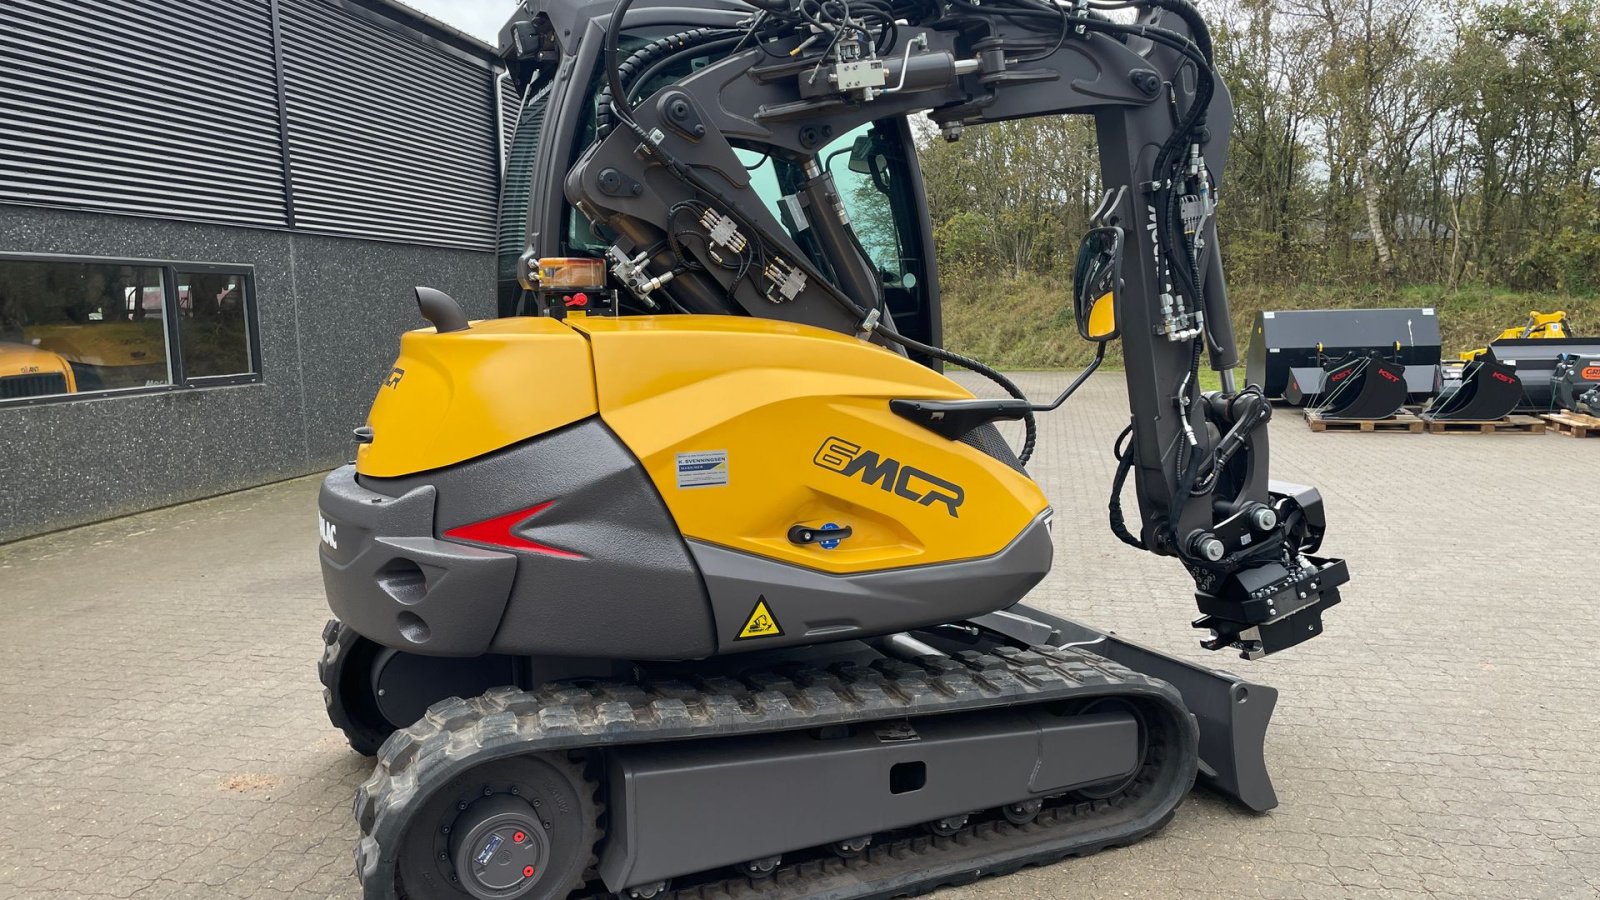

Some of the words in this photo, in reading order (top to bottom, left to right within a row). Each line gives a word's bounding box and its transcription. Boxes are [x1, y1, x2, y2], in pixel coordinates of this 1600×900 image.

[1378, 368, 1400, 383] KST
[1492, 371, 1516, 384] KST
[813, 436, 965, 519] 6MCR
